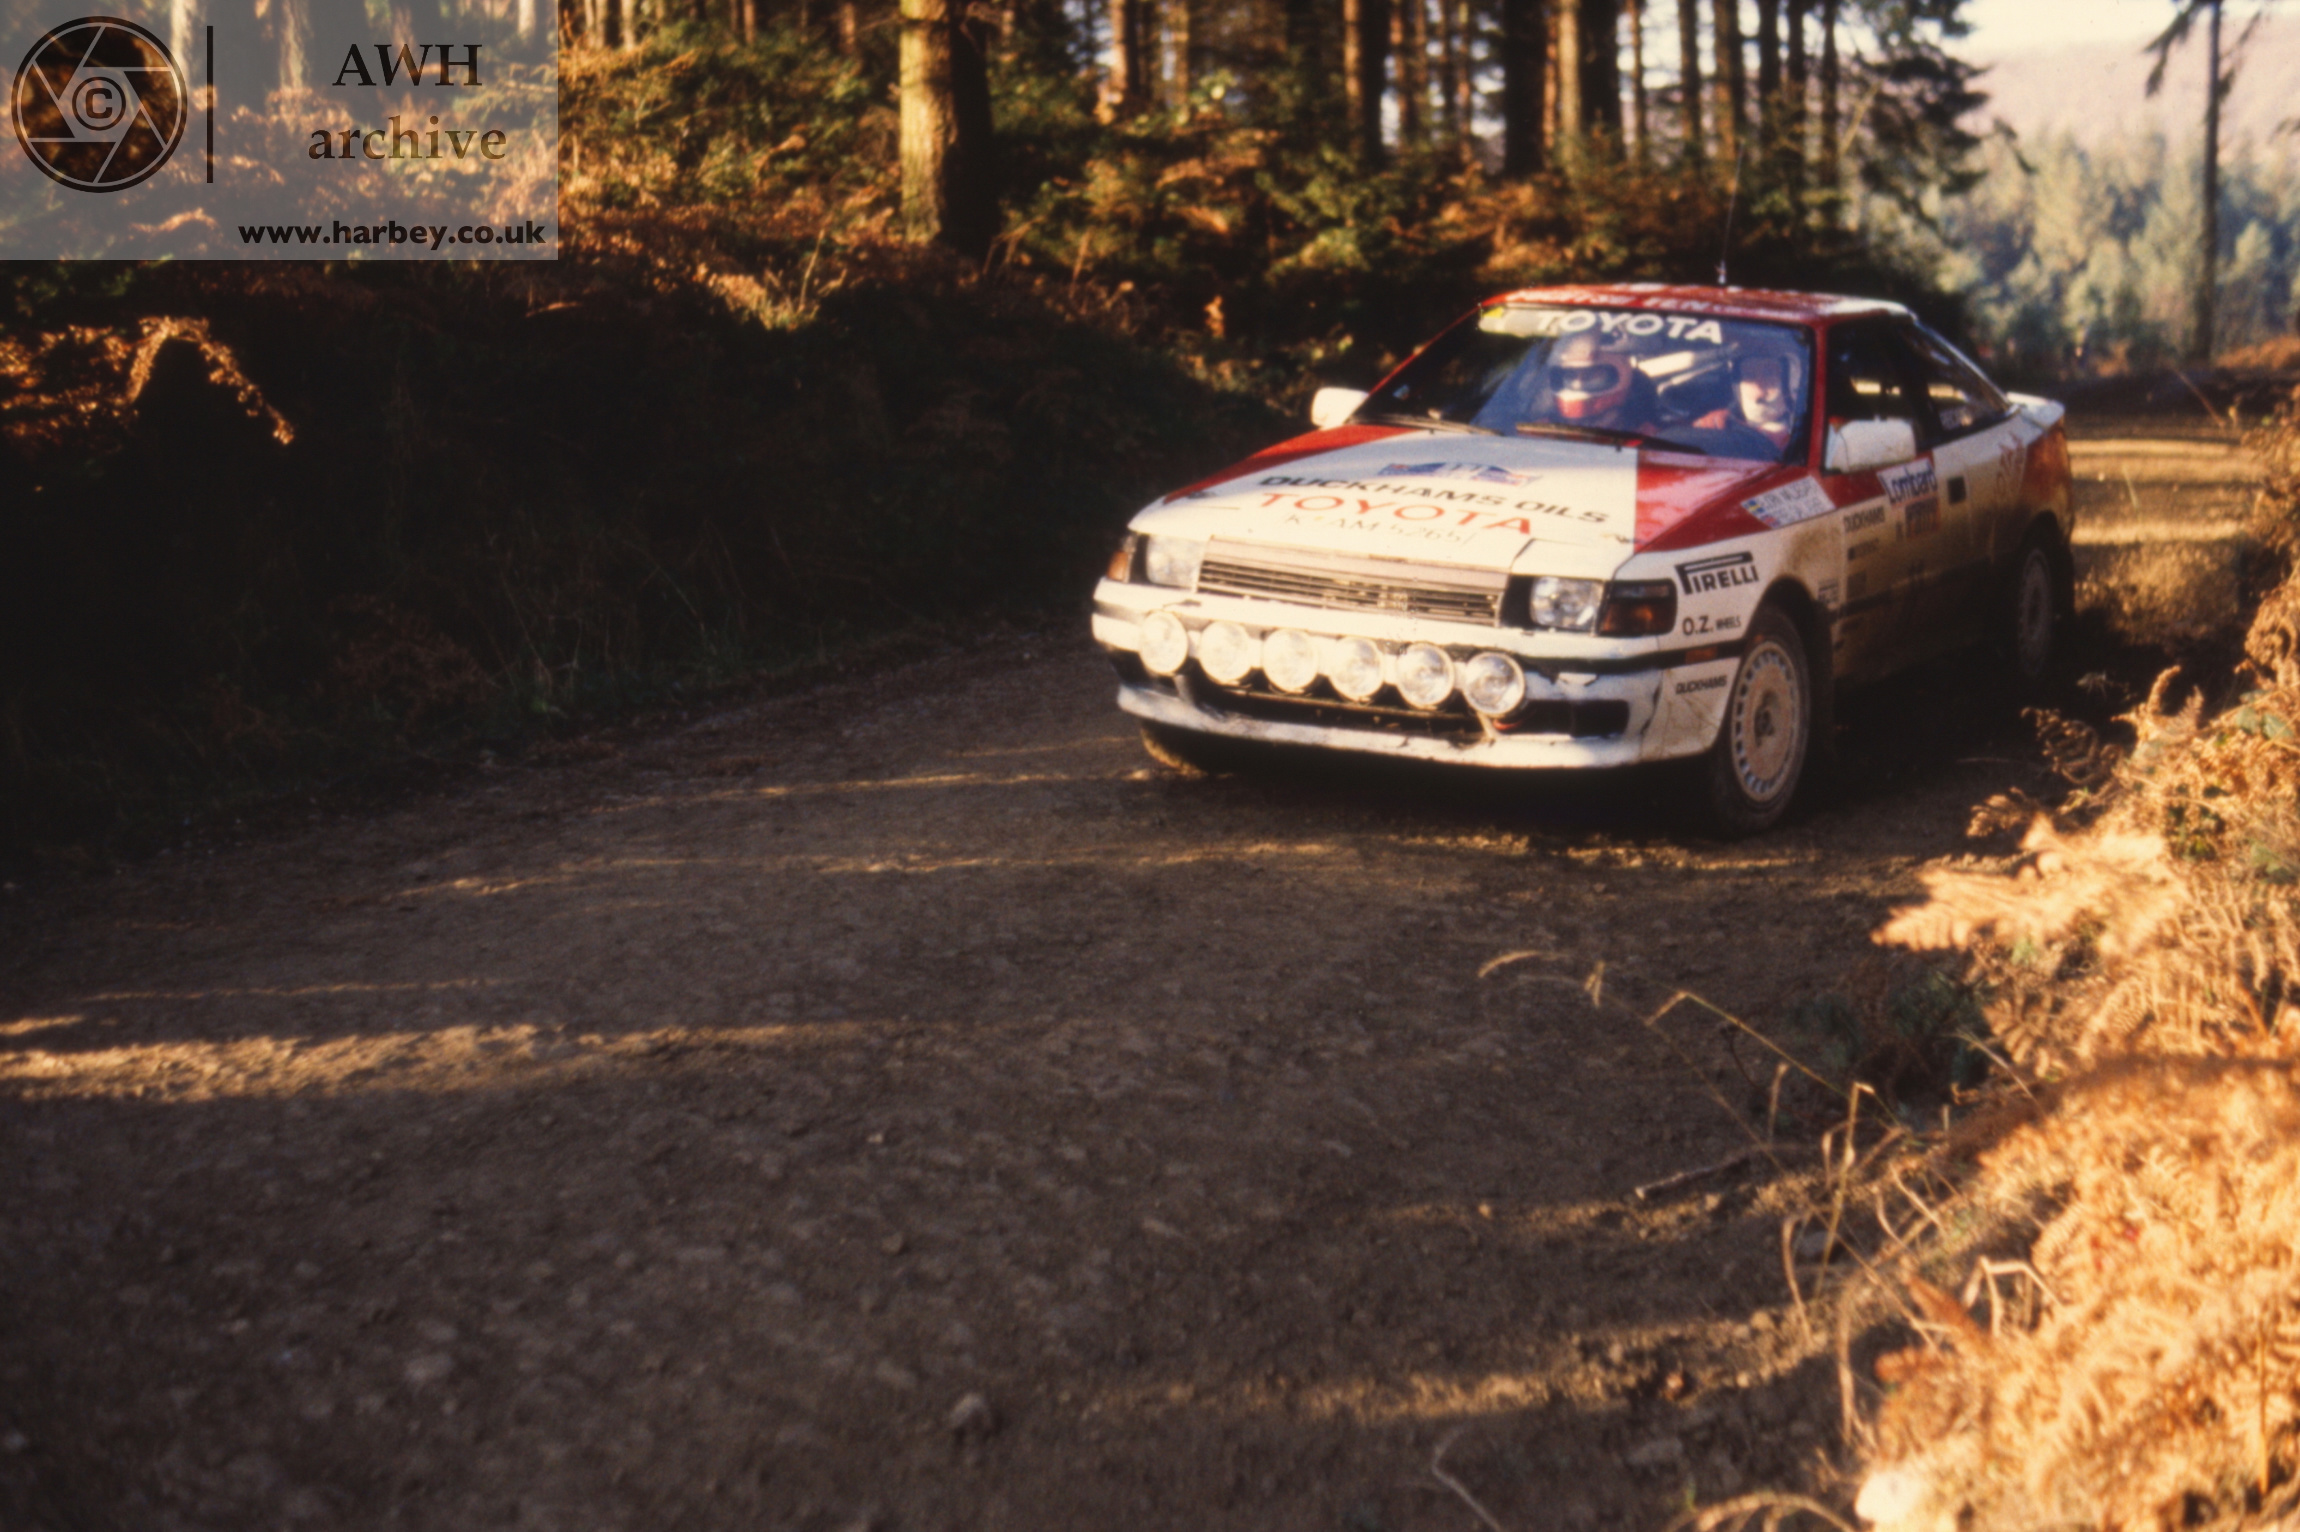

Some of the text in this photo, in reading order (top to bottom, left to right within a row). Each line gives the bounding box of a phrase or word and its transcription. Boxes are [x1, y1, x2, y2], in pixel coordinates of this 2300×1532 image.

[1536, 309, 1722, 345] TOYOTA
[1258, 476, 1610, 523] DUCKHAMS OILS
[1260, 492, 1531, 536] TOYOTA
[1674, 550, 1760, 595] PIRELLI
[1681, 614, 1715, 637] O.Z.
[1675, 674, 1728, 695] DUCKHAMS
